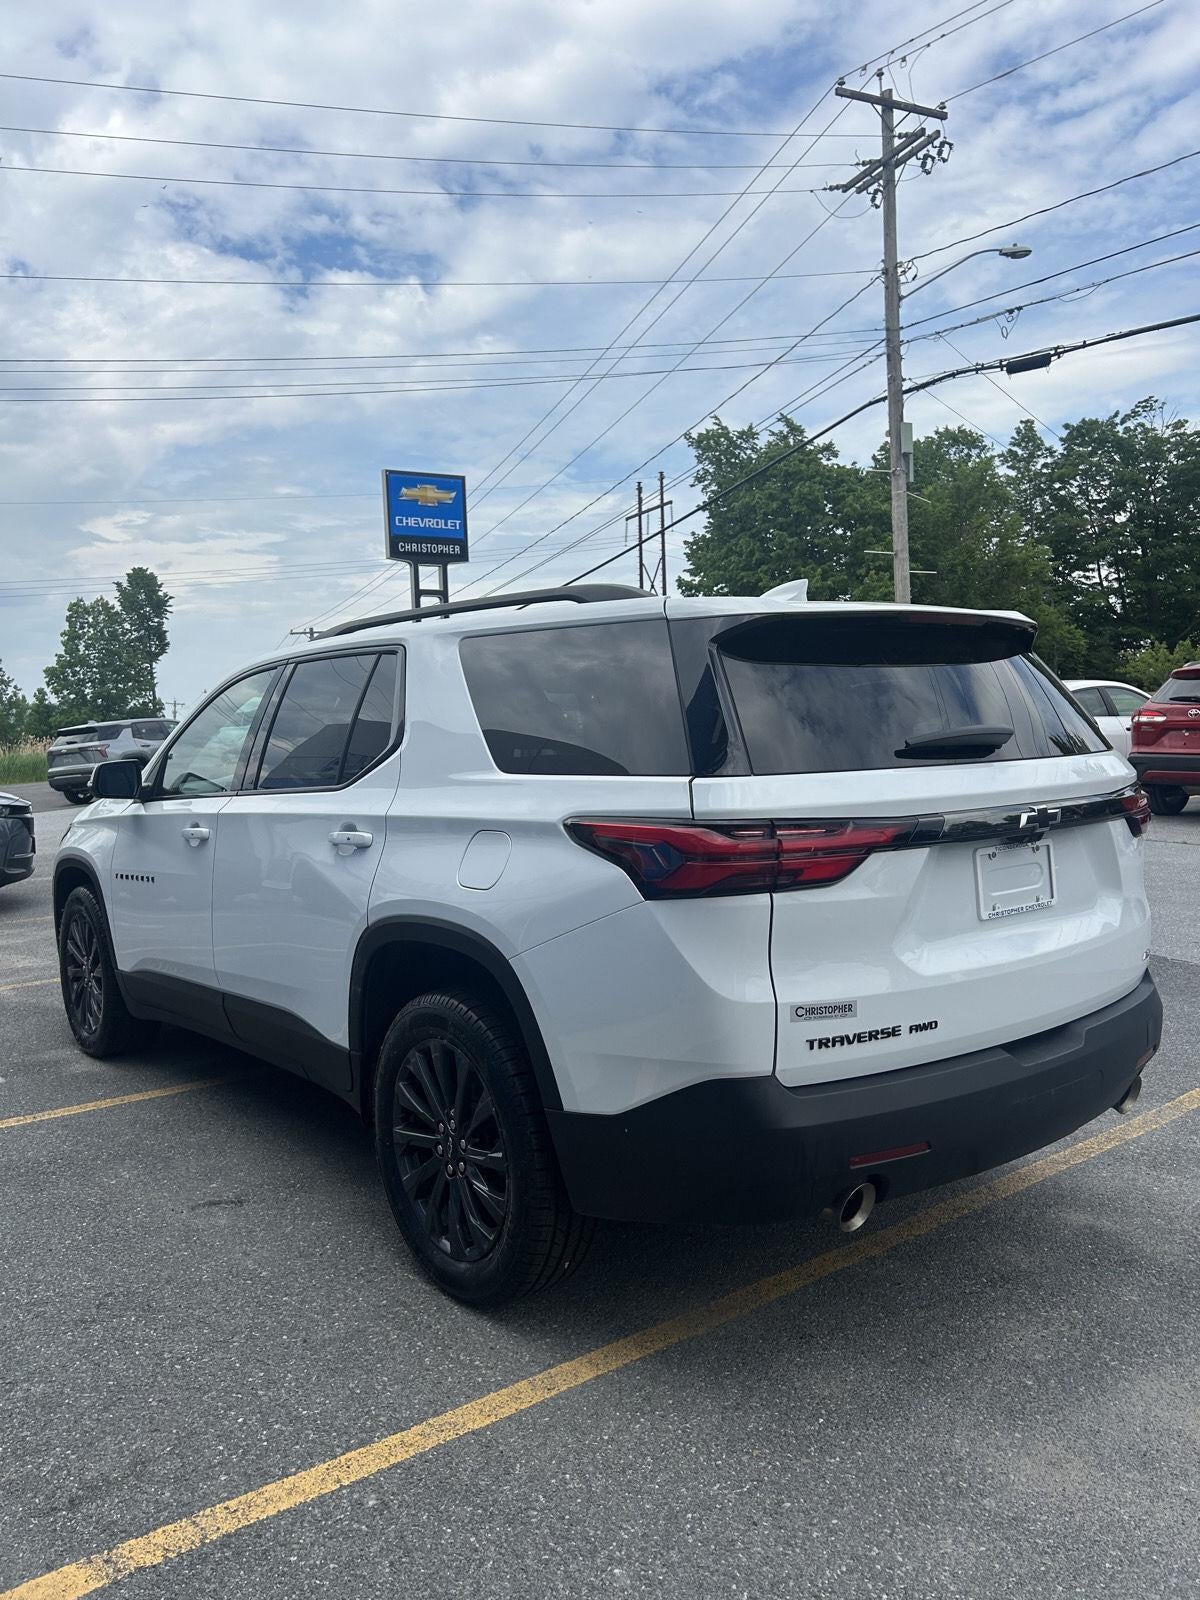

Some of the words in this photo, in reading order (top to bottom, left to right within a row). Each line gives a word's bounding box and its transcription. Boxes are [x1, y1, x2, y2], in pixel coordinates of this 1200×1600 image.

[395, 516, 461, 530] CHEVROLET
[398, 542, 461, 554] CHRISTOPHER
[988, 906, 1024, 919] CHRISTOPHER
[1025, 900, 1053, 911] CHEVROLET
[795, 1003, 853, 1018] CHRISTOPHER
[805, 1024, 902, 1051] TRAVERSE
[909, 1020, 938, 1035] AWD
